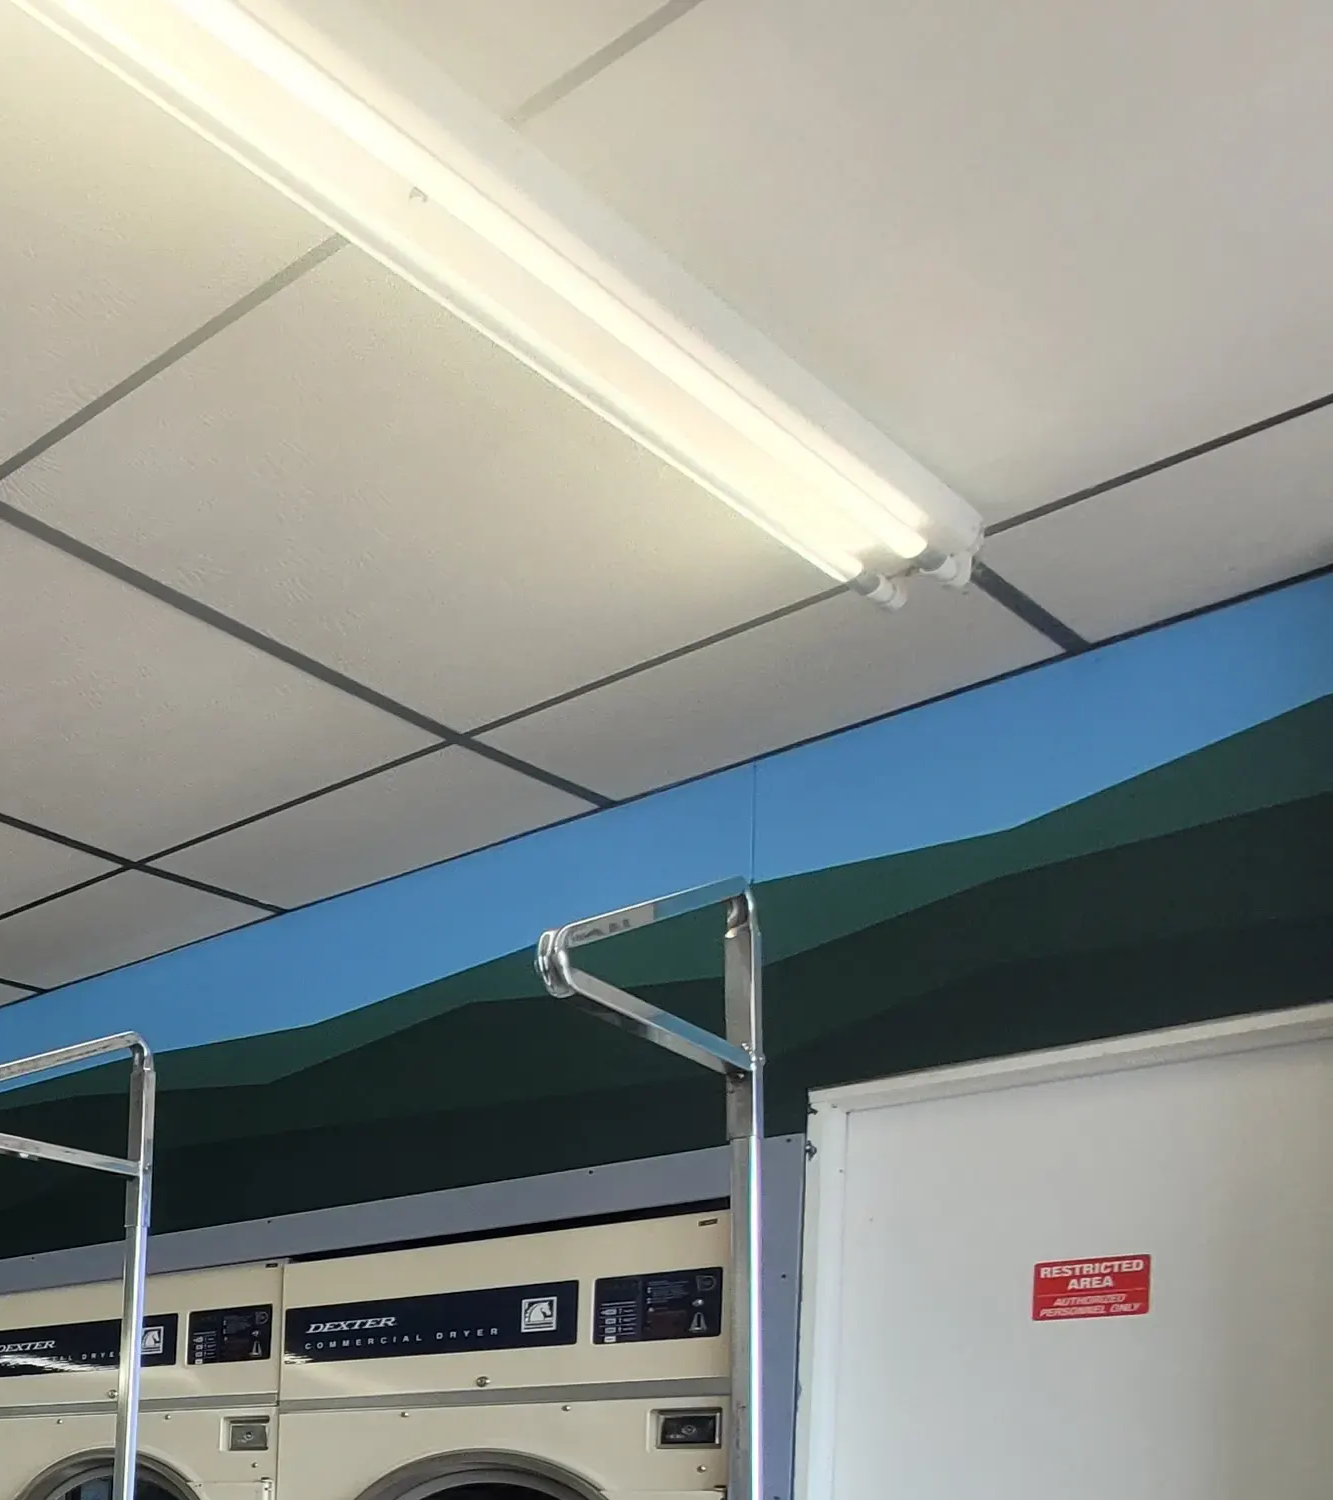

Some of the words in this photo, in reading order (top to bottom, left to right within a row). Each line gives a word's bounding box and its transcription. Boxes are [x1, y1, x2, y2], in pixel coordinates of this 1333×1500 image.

[1040, 1260, 1144, 1278] RESTRICTED
[1067, 1276, 1114, 1290] AREA
[1053, 1293, 1127, 1306] AUTHORIZED
[1039, 1305, 1106, 1317] PERSONNEL
[1110, 1302, 1141, 1313] ONLY
[306, 1317, 397, 1333] DEXTER
[305, 1334, 423, 1350] COMMERCIAL
[436, 1327, 499, 1340] DRYER
[82, 1352, 121, 1361] DRYE
